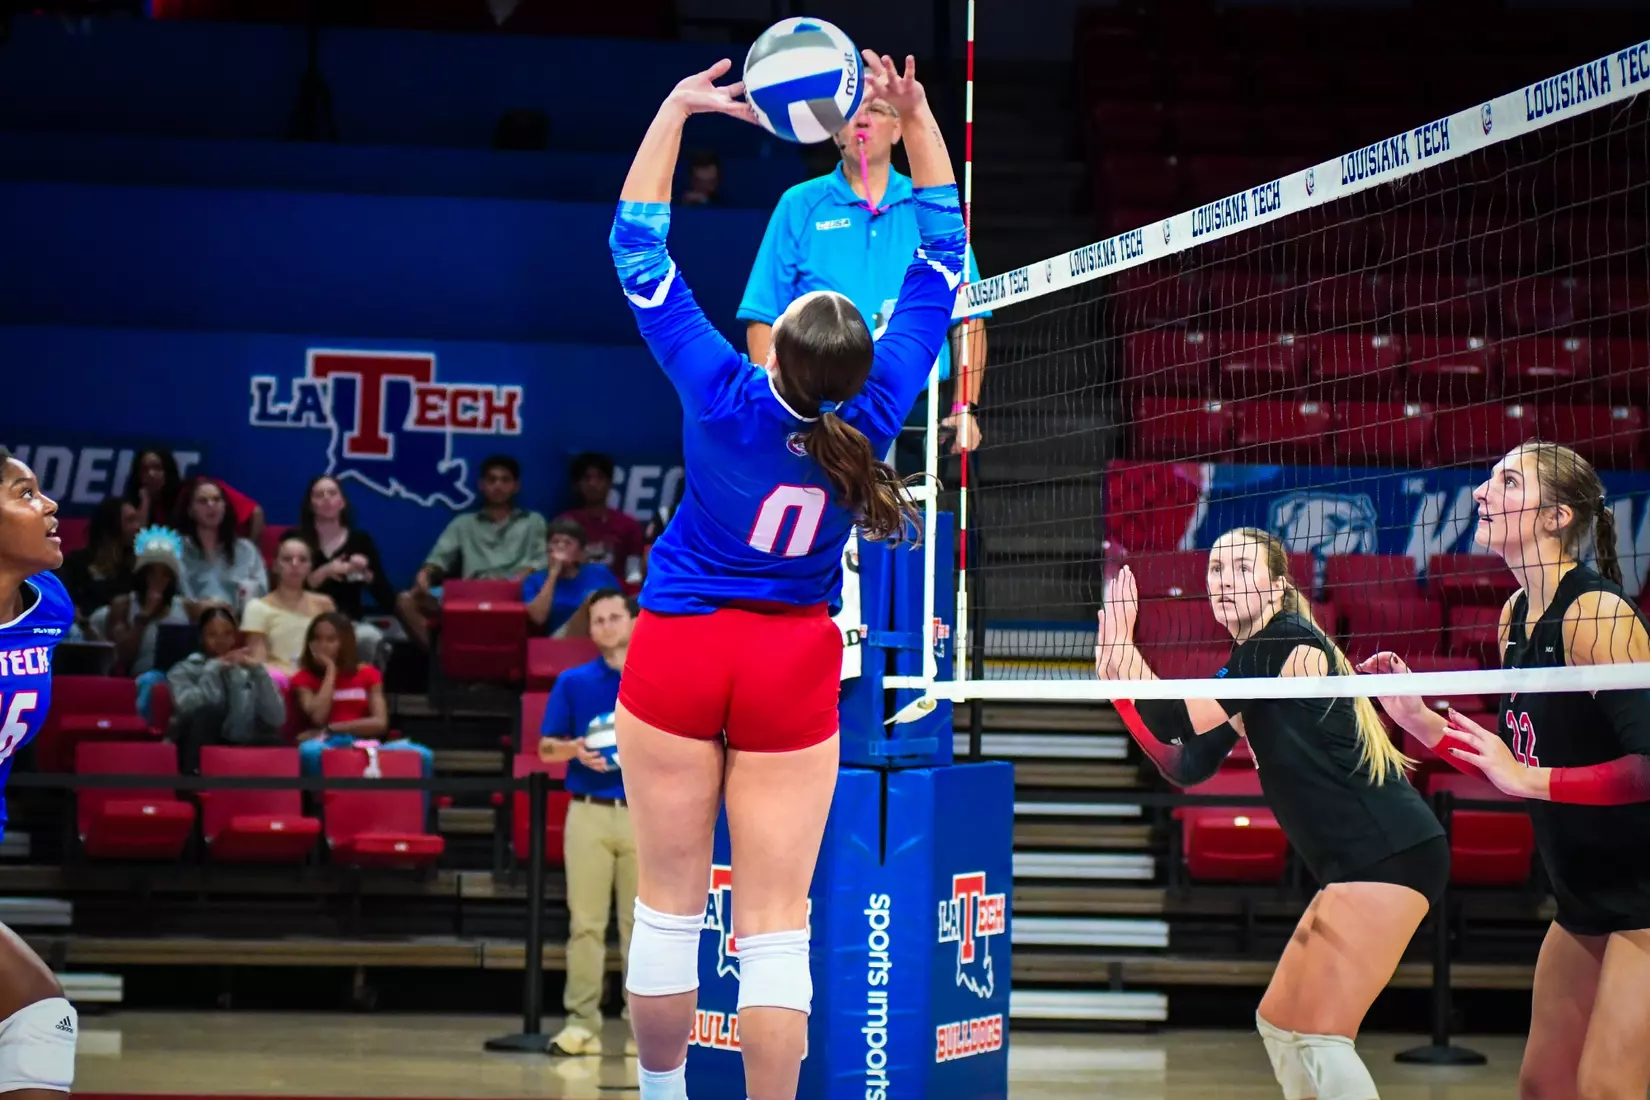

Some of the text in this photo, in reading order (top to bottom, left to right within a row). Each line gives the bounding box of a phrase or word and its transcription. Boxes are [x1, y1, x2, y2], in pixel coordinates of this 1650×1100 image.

[1525, 43, 1650, 121] LOUISIANA TEC
[1340, 118, 1450, 185] LOUISIANA TECH
[1192, 180, 1281, 237] LOUISIANA TECH
[1069, 229, 1143, 277] LOUISIANA TECH
[966, 267, 1029, 308] LOUISIANA TECH
[250, 376, 334, 428] LA
[1506, 709, 1540, 768] 22
[861, 894, 892, 1100] sports imports
[55, 1024, 73, 1034] adidas
[936, 1014, 1002, 1063] BULLDOGS
